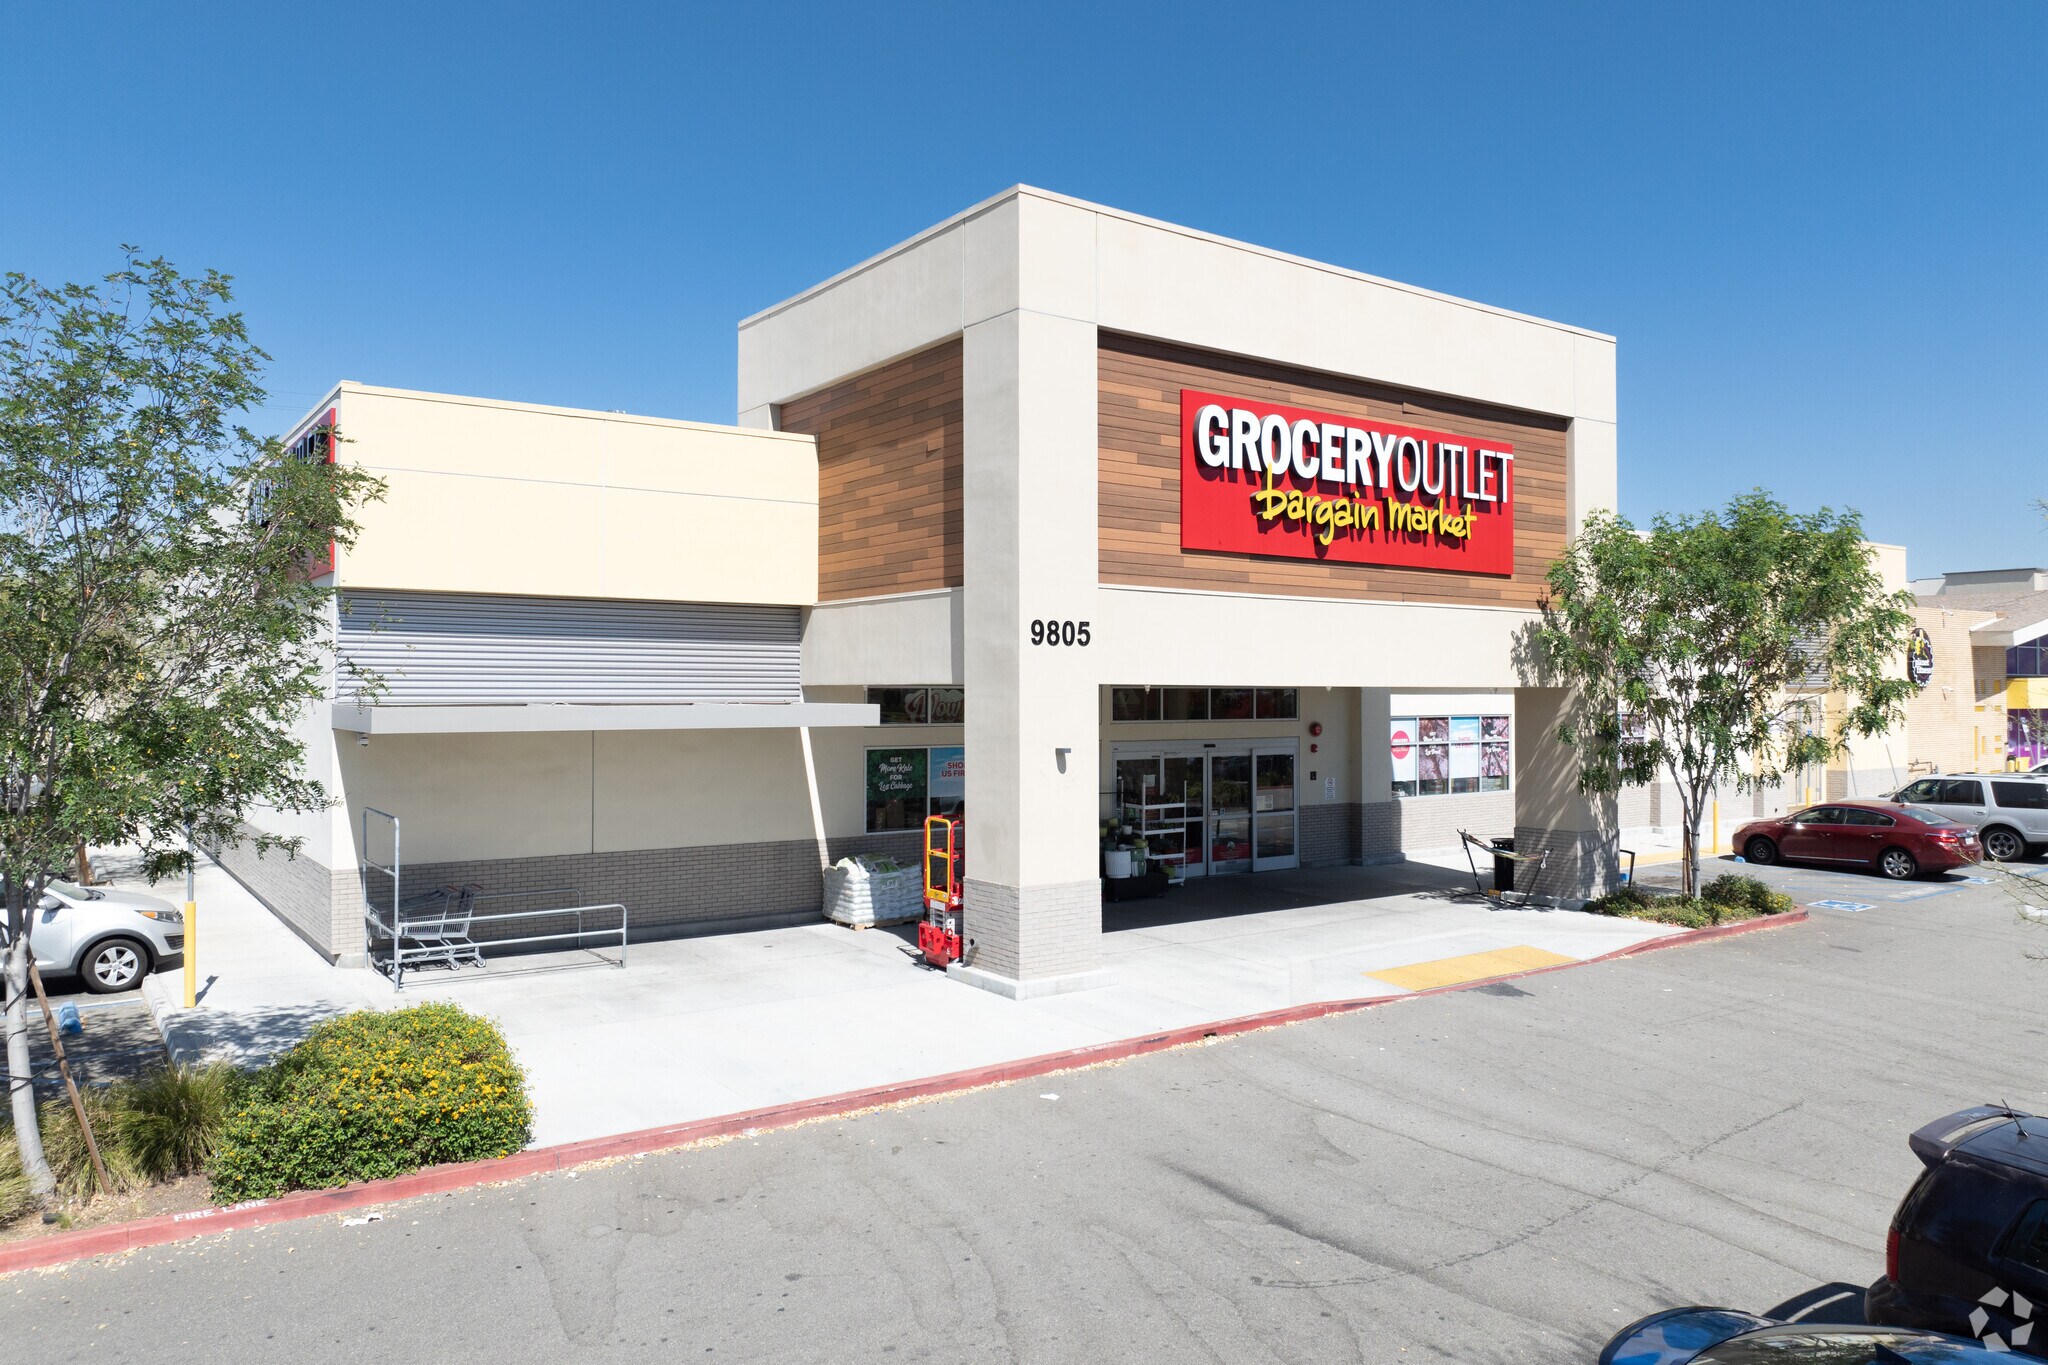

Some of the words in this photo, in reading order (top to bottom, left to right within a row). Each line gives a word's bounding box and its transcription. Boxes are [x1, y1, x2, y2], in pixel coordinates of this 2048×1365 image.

[1197, 403, 1397, 488] GROCERY
[1397, 436, 1514, 503] OUTLET
[1030, 619, 1091, 647] 9805
[941, 770, 952, 778] US
[174, 1208, 215, 1222] FIRE
[221, 1199, 269, 1213] LANE
